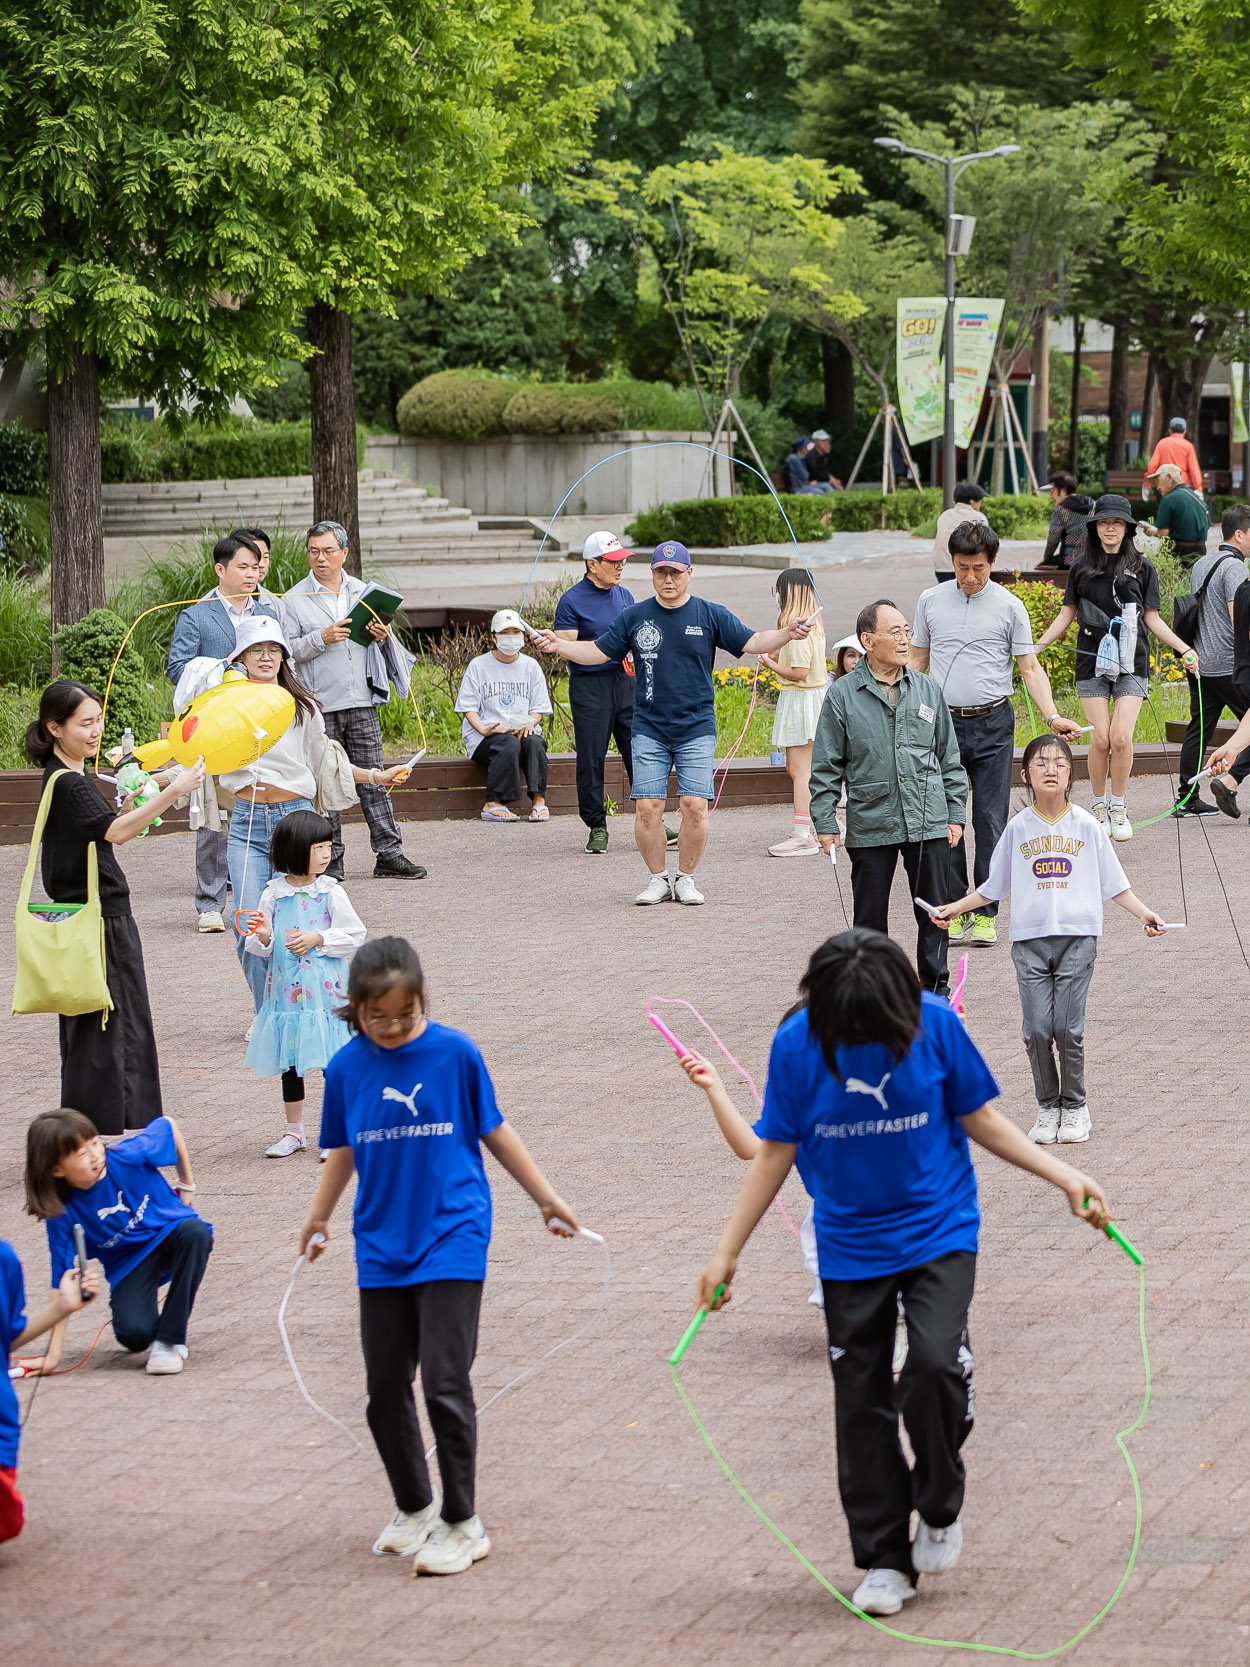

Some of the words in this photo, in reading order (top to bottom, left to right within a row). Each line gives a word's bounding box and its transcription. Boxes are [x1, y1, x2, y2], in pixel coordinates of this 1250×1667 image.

[901, 318, 936, 337] GO!
[482, 681, 529, 700] CALIFORNIA
[1020, 835, 1085, 860] SUNDAY
[1035, 861, 1068, 875] SOCIAL
[1056, 881, 1068, 889] DAY
[356, 1122, 454, 1144] FOREVERFASTER
[815, 1112, 929, 1139] FOREVERFASTER
